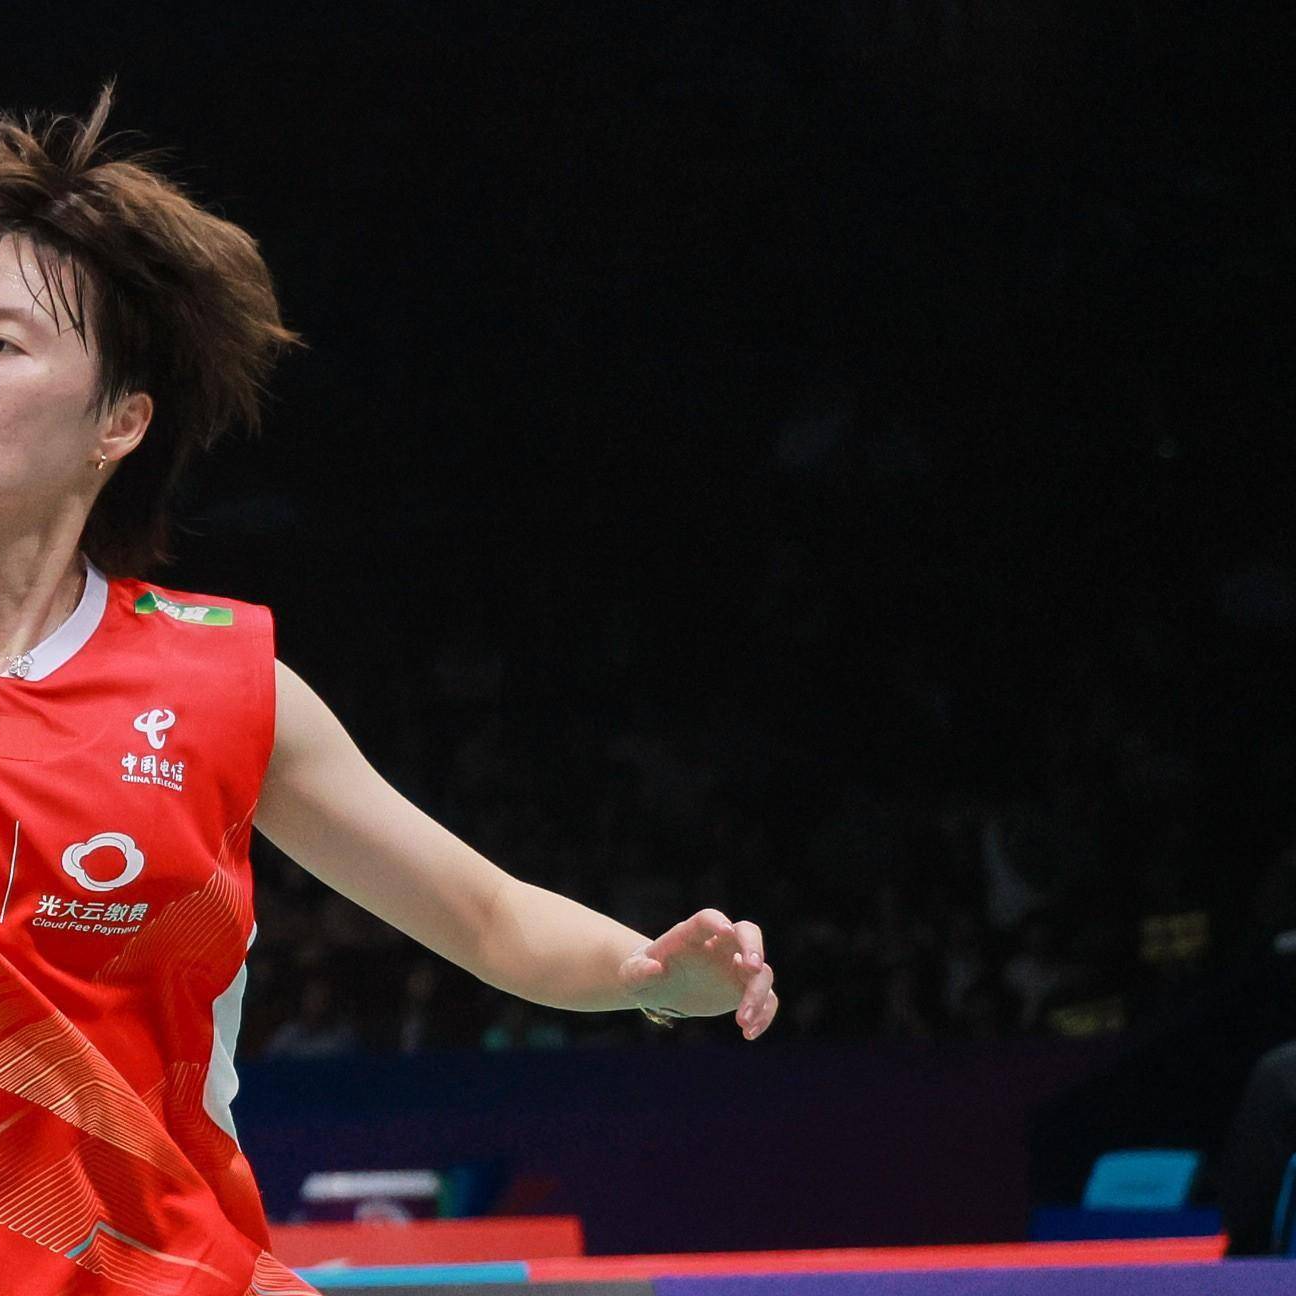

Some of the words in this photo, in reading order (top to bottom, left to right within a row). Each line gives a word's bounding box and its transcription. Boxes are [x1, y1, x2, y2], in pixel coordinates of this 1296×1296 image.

[121, 752, 185, 782] 中国电信
[121, 774, 151, 785] CHINA
[151, 777, 183, 792] TELECOM
[34, 895, 149, 922] 光大云缴费
[32, 917, 68, 930] Cloud
[67, 921, 90, 932] Fee
[92, 924, 140, 936] Payment
